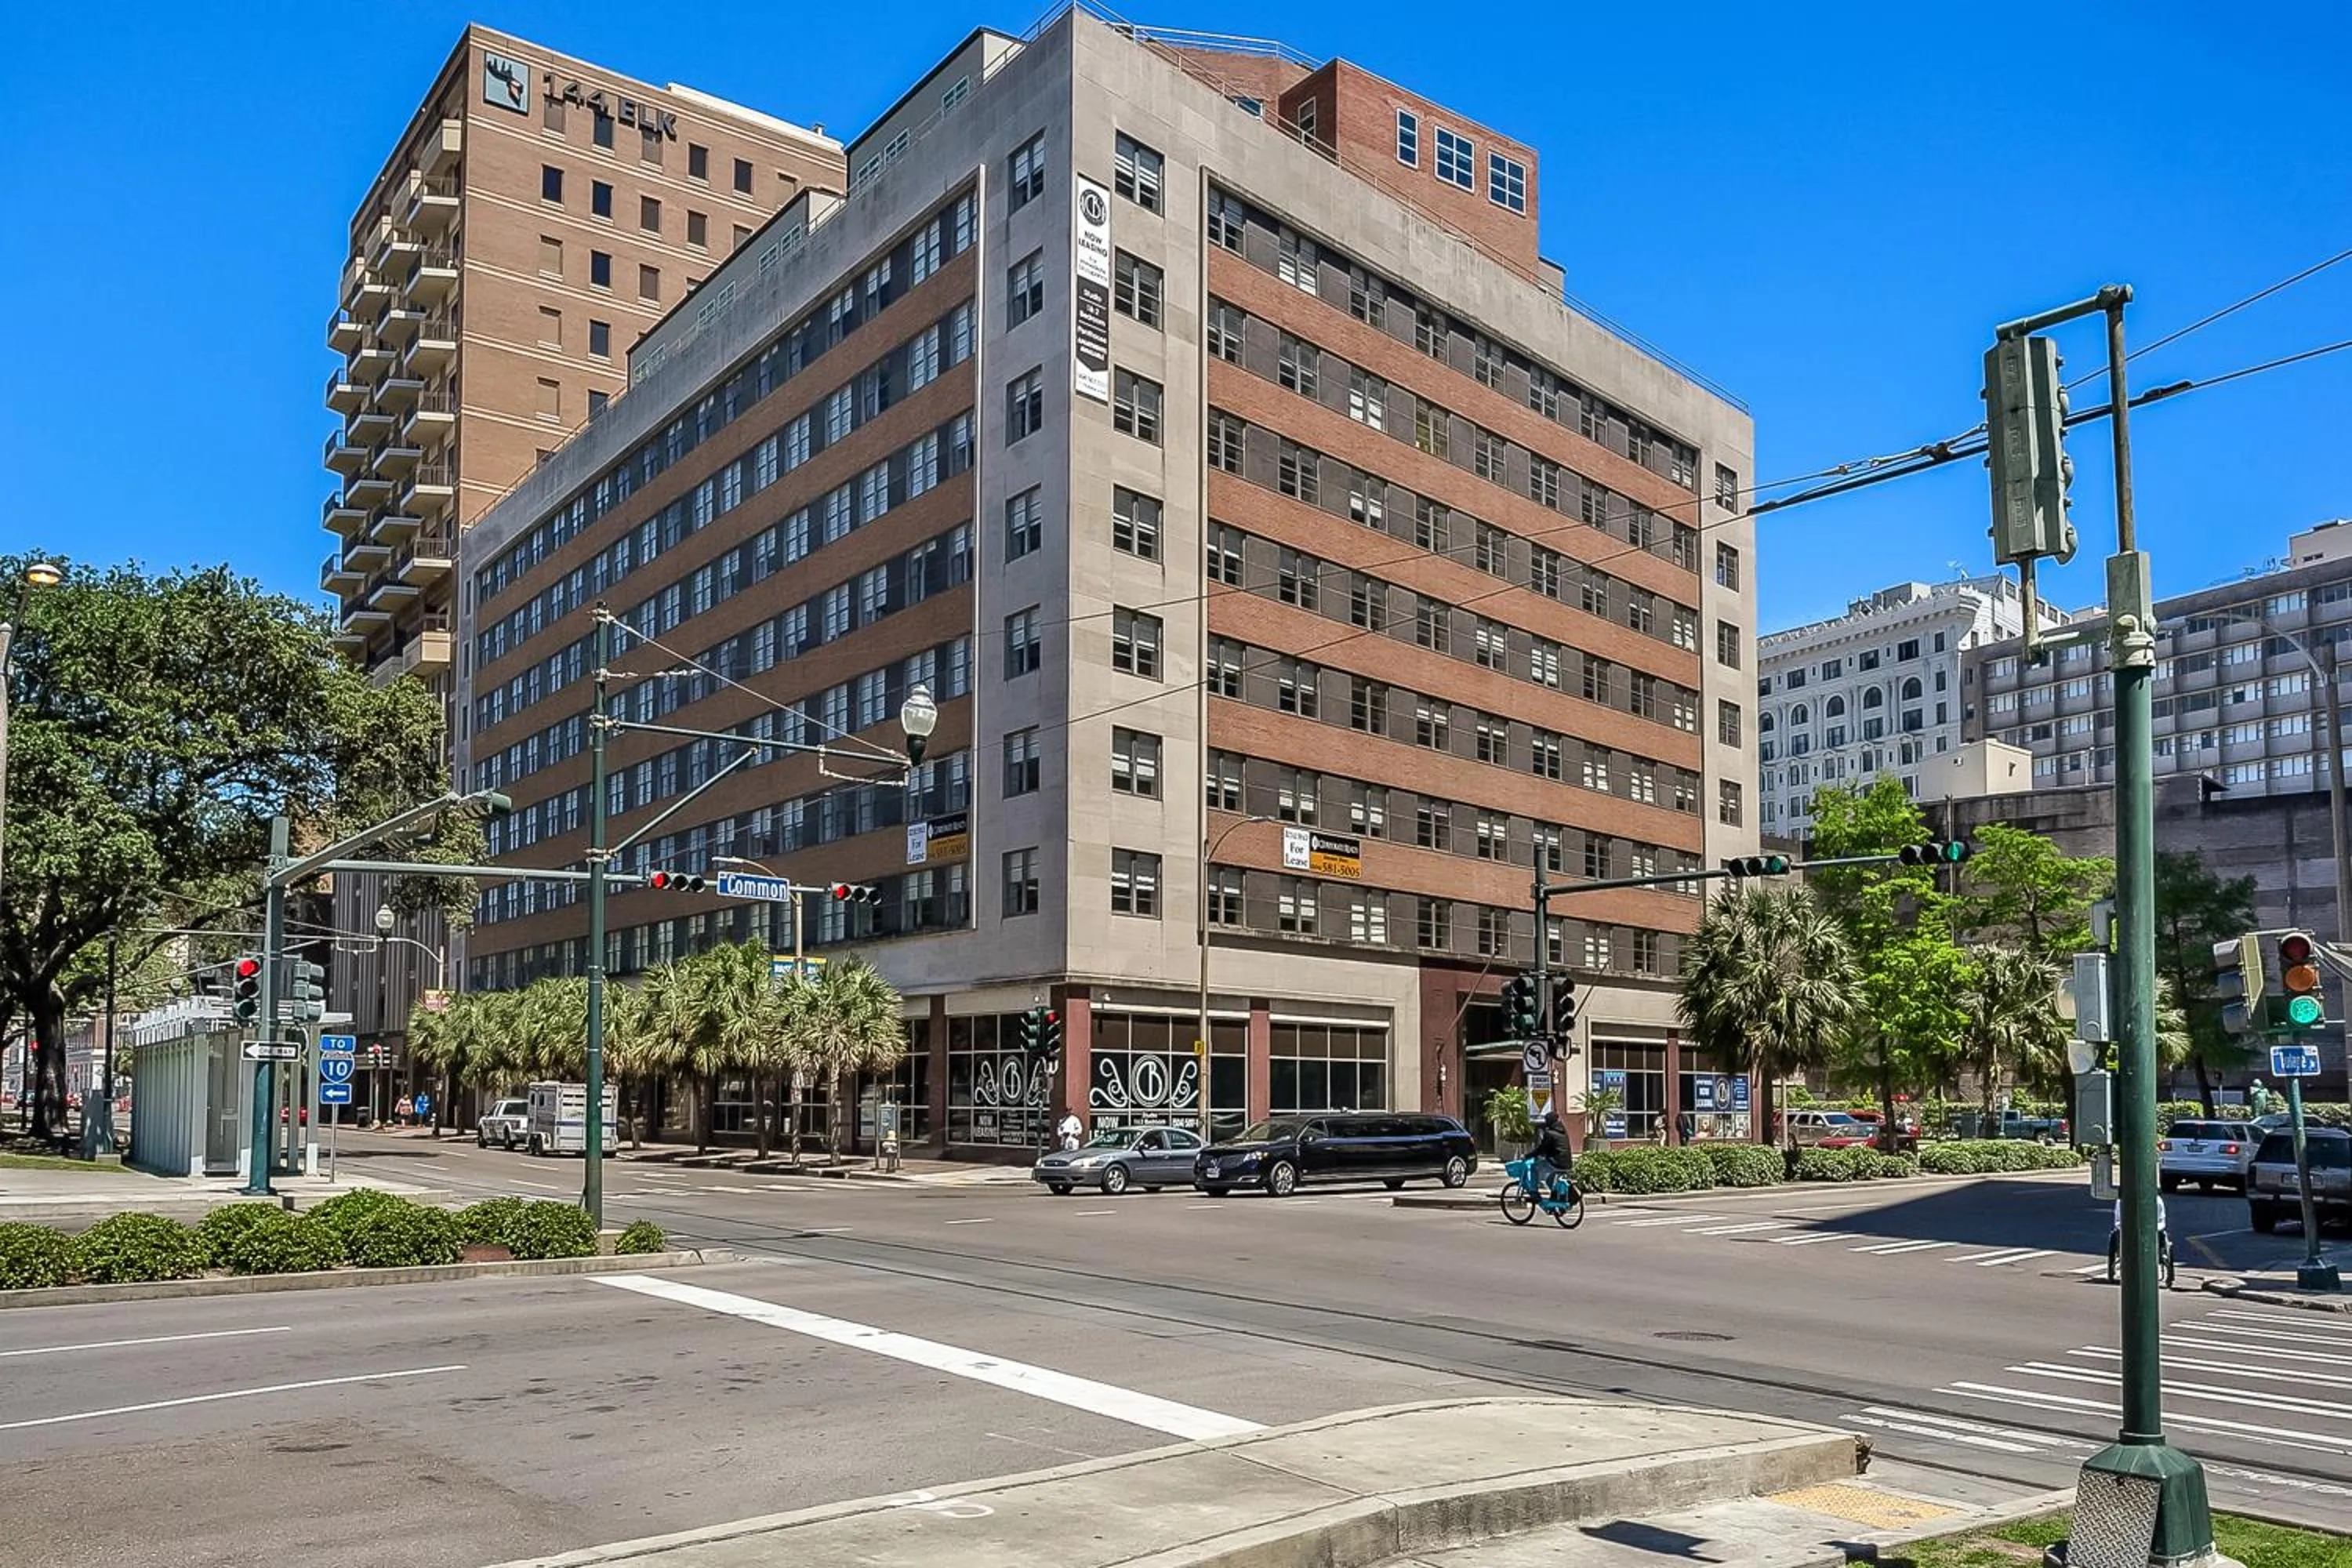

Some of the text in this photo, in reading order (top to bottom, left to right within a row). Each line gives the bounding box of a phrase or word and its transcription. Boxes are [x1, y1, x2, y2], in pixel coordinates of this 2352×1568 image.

[618, 96, 677, 137] ELK
[1084, 230, 1102, 245] NOW
[1078, 237, 1107, 258] LEASING
[1290, 841, 1305, 854] For
[1285, 852, 1308, 867] Lease
[727, 874, 786, 900] Common
[329, 1039, 346, 1049] TO
[328, 1061, 348, 1077] 10
[1097, 1116, 1120, 1129] NOW
